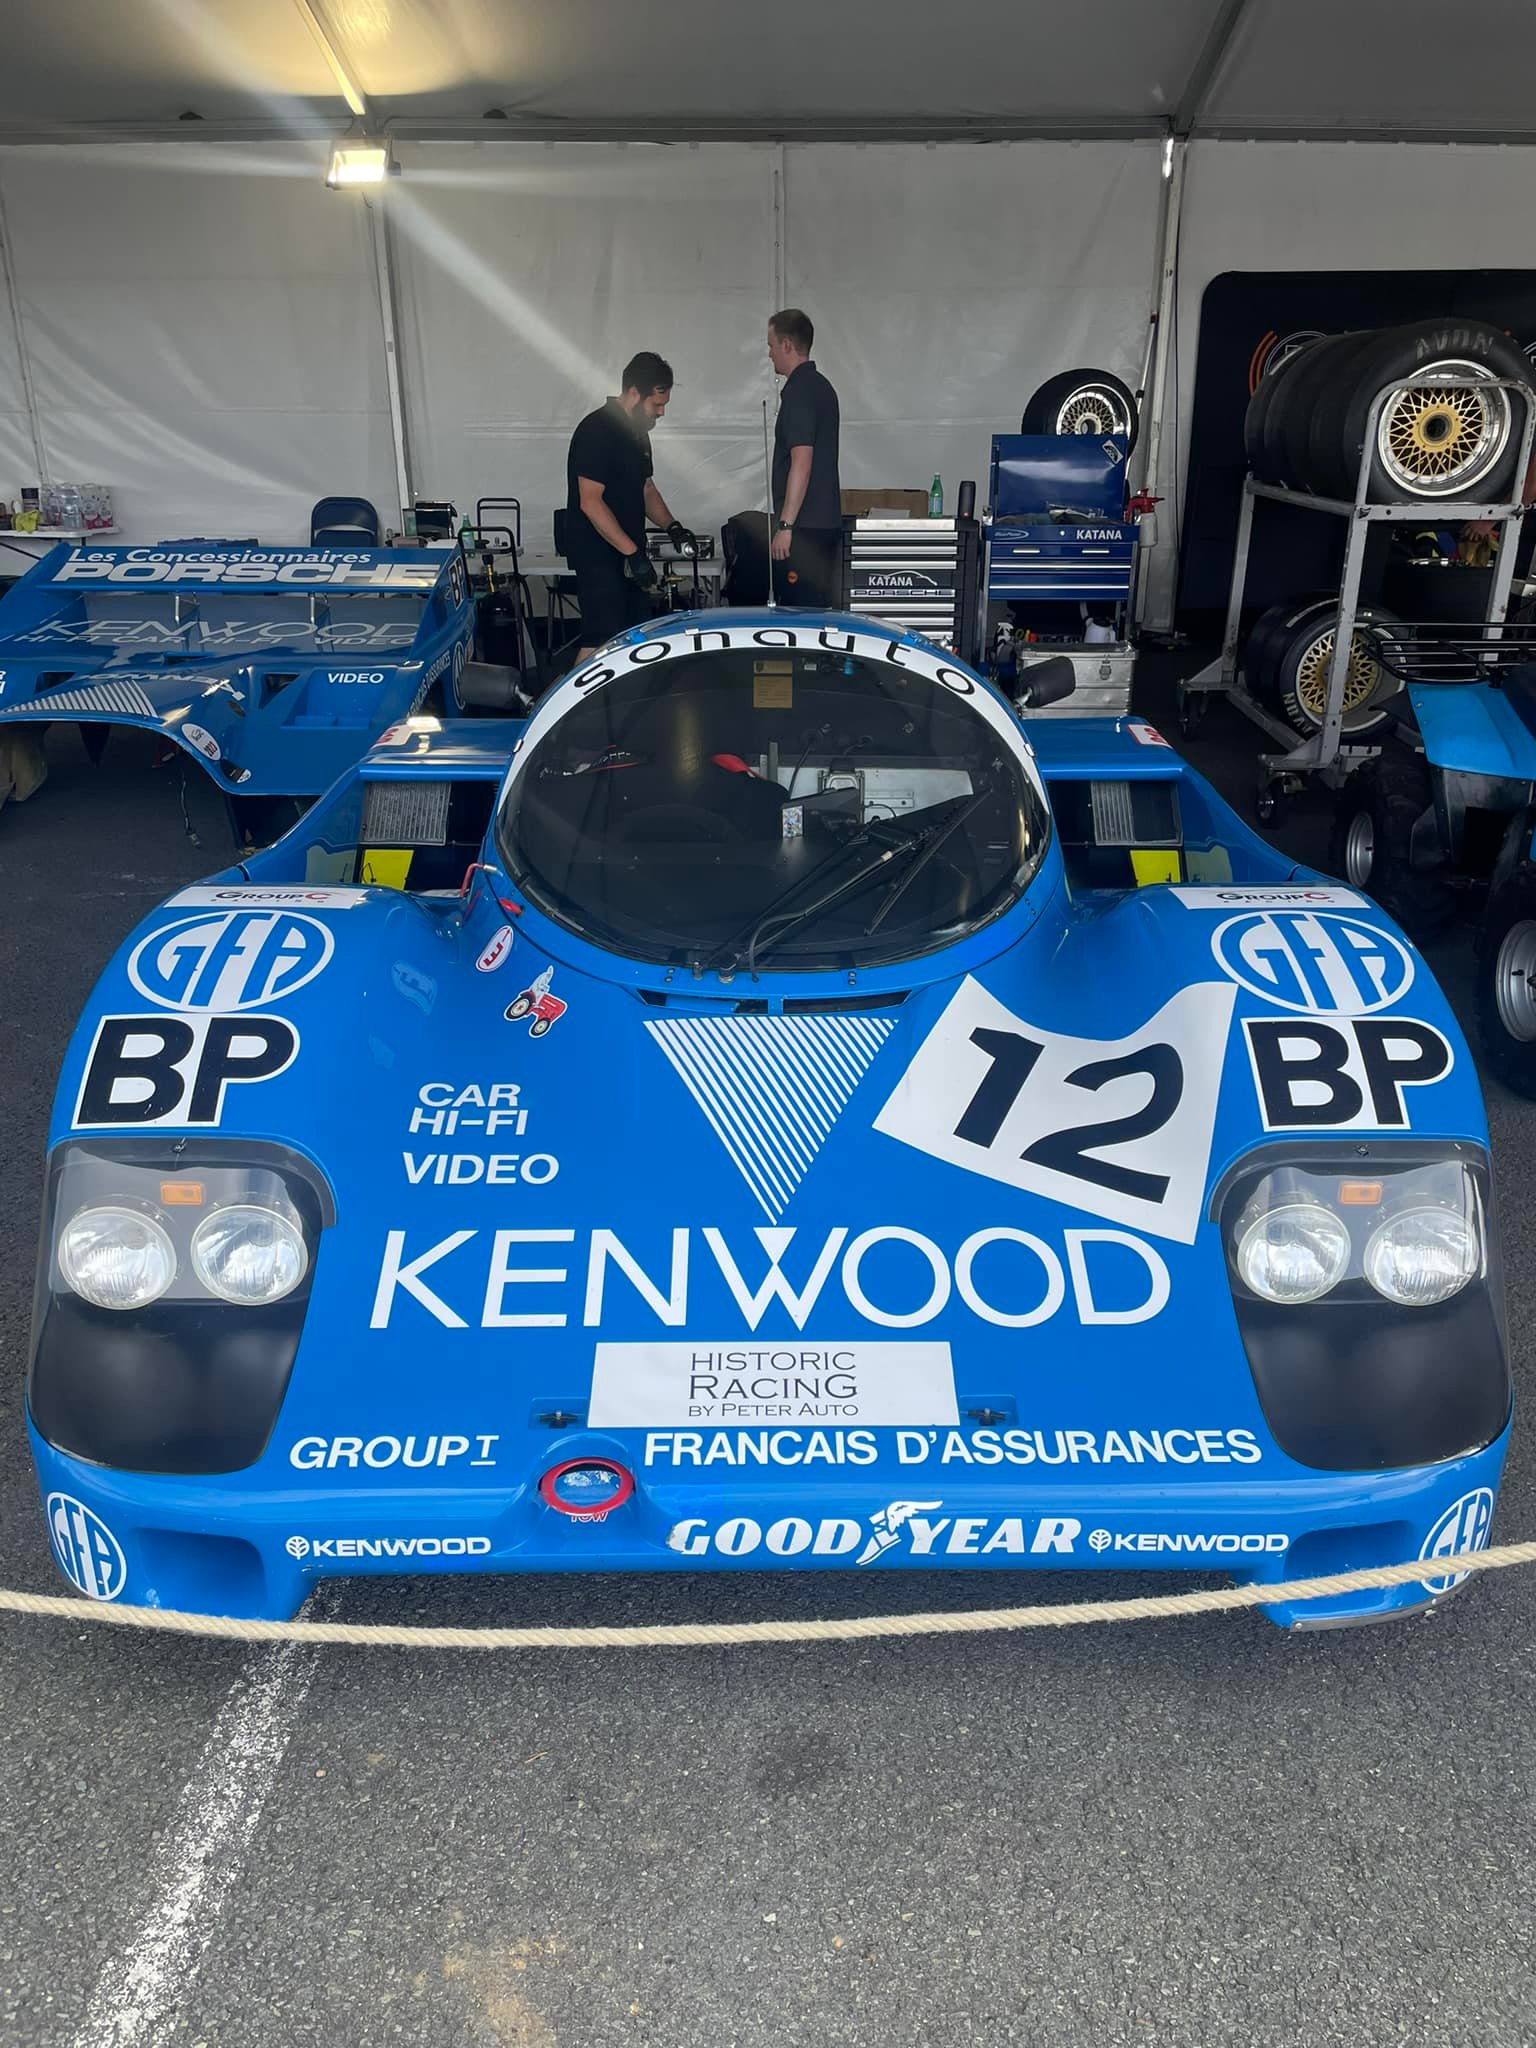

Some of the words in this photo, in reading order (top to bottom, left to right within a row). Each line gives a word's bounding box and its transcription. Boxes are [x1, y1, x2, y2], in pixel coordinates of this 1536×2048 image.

[1416, 329, 1494, 360] AVON
[1076, 529, 1122, 540] KATANA
[68, 549, 117, 562] Les
[126, 549, 372, 563] Concessionnaires
[51, 563, 440, 587] PORSCHE
[868, 576, 913, 586] KATANA
[14, 635, 99, 643] HI-FI
[112, 635, 187, 643] CAR
[313, 637, 415, 645] VIDEO
[29, 620, 421, 637] KENWOOD
[574, 628, 975, 696] sonauto
[327, 673, 384, 684] VIDEO
[74, 1015, 298, 1127] BP
[1244, 1018, 1451, 1129] BP
[418, 1082, 521, 1108] CAR
[408, 1107, 529, 1136] HI-FI
[952, 1026, 1185, 1204] 12
[402, 1151, 560, 1185] VIDEO
[369, 1226, 1171, 1332] KENWOOD
[691, 1351, 857, 1371] HISTORIC
[688, 1374, 858, 1400] RACING
[688, 1405, 714, 1417] BY
[721, 1403, 792, 1417] PETER
[798, 1402, 859, 1416] AUTO
[644, 1431, 878, 1466] FRANCAIS
[896, 1429, 1263, 1465] D'ASSURANCES
[313, 1537, 492, 1557] KENWOOD
[1114, 1534, 1290, 1553] KENWOOD
